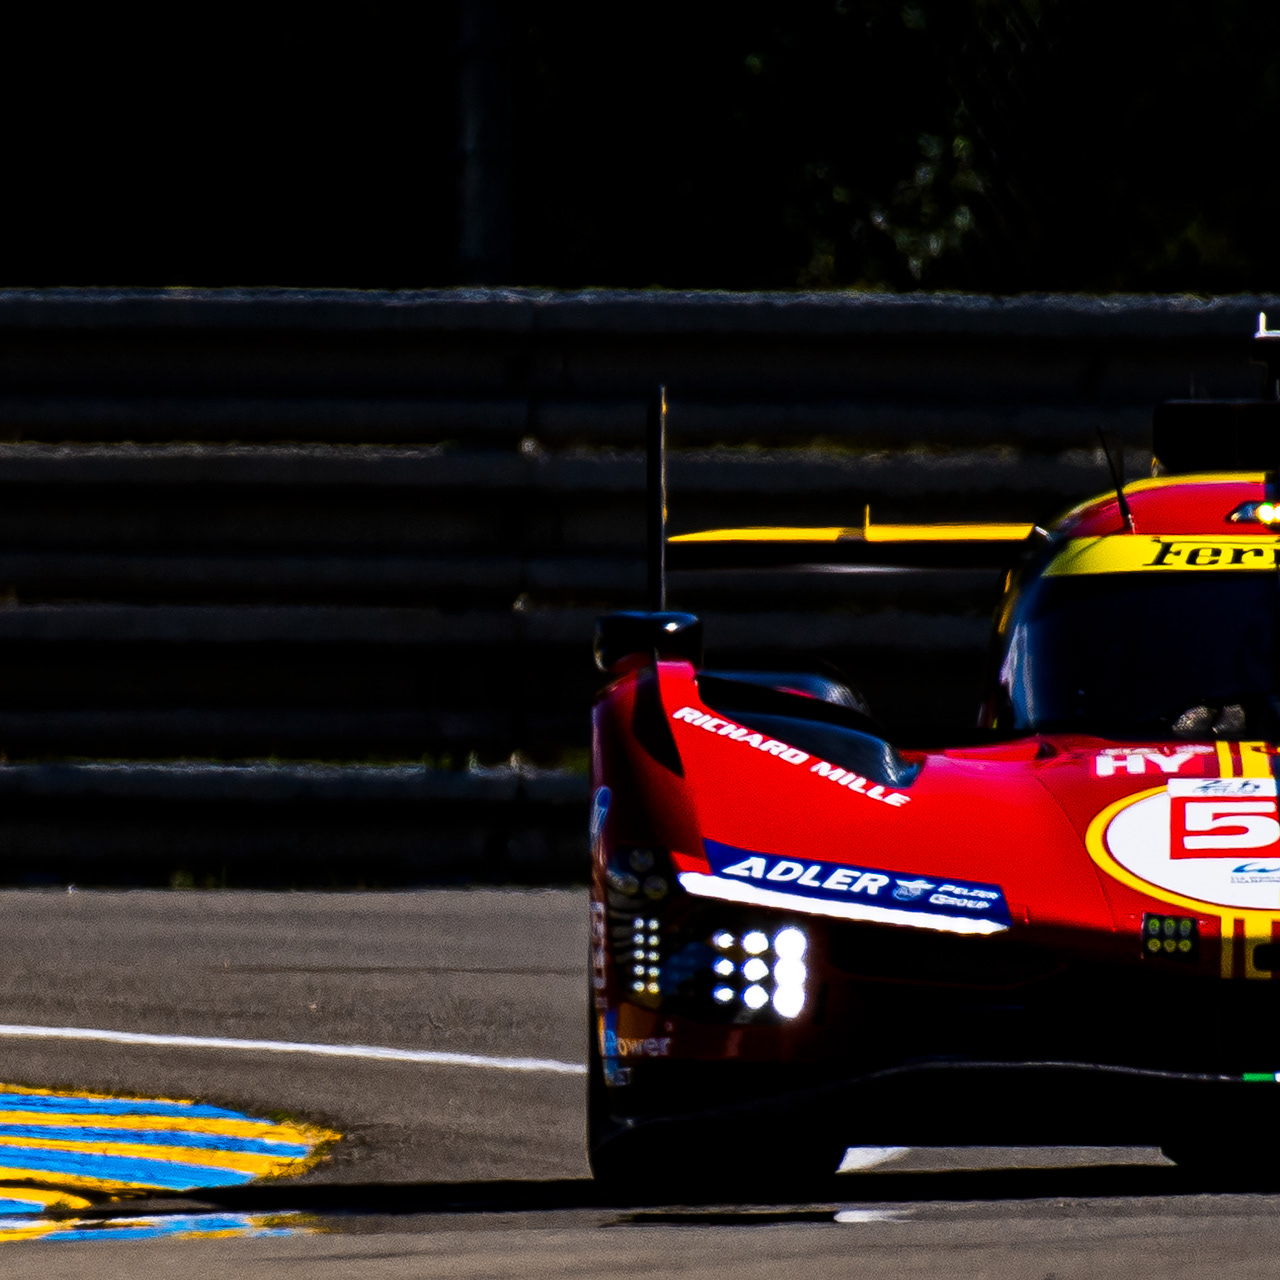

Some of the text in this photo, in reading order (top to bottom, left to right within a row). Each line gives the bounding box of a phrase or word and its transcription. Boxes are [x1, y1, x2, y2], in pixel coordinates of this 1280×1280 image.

[672, 706, 911, 807] RICHARD MILLE
[1096, 753, 1195, 776] HY
[721, 856, 890, 895] ADLER
